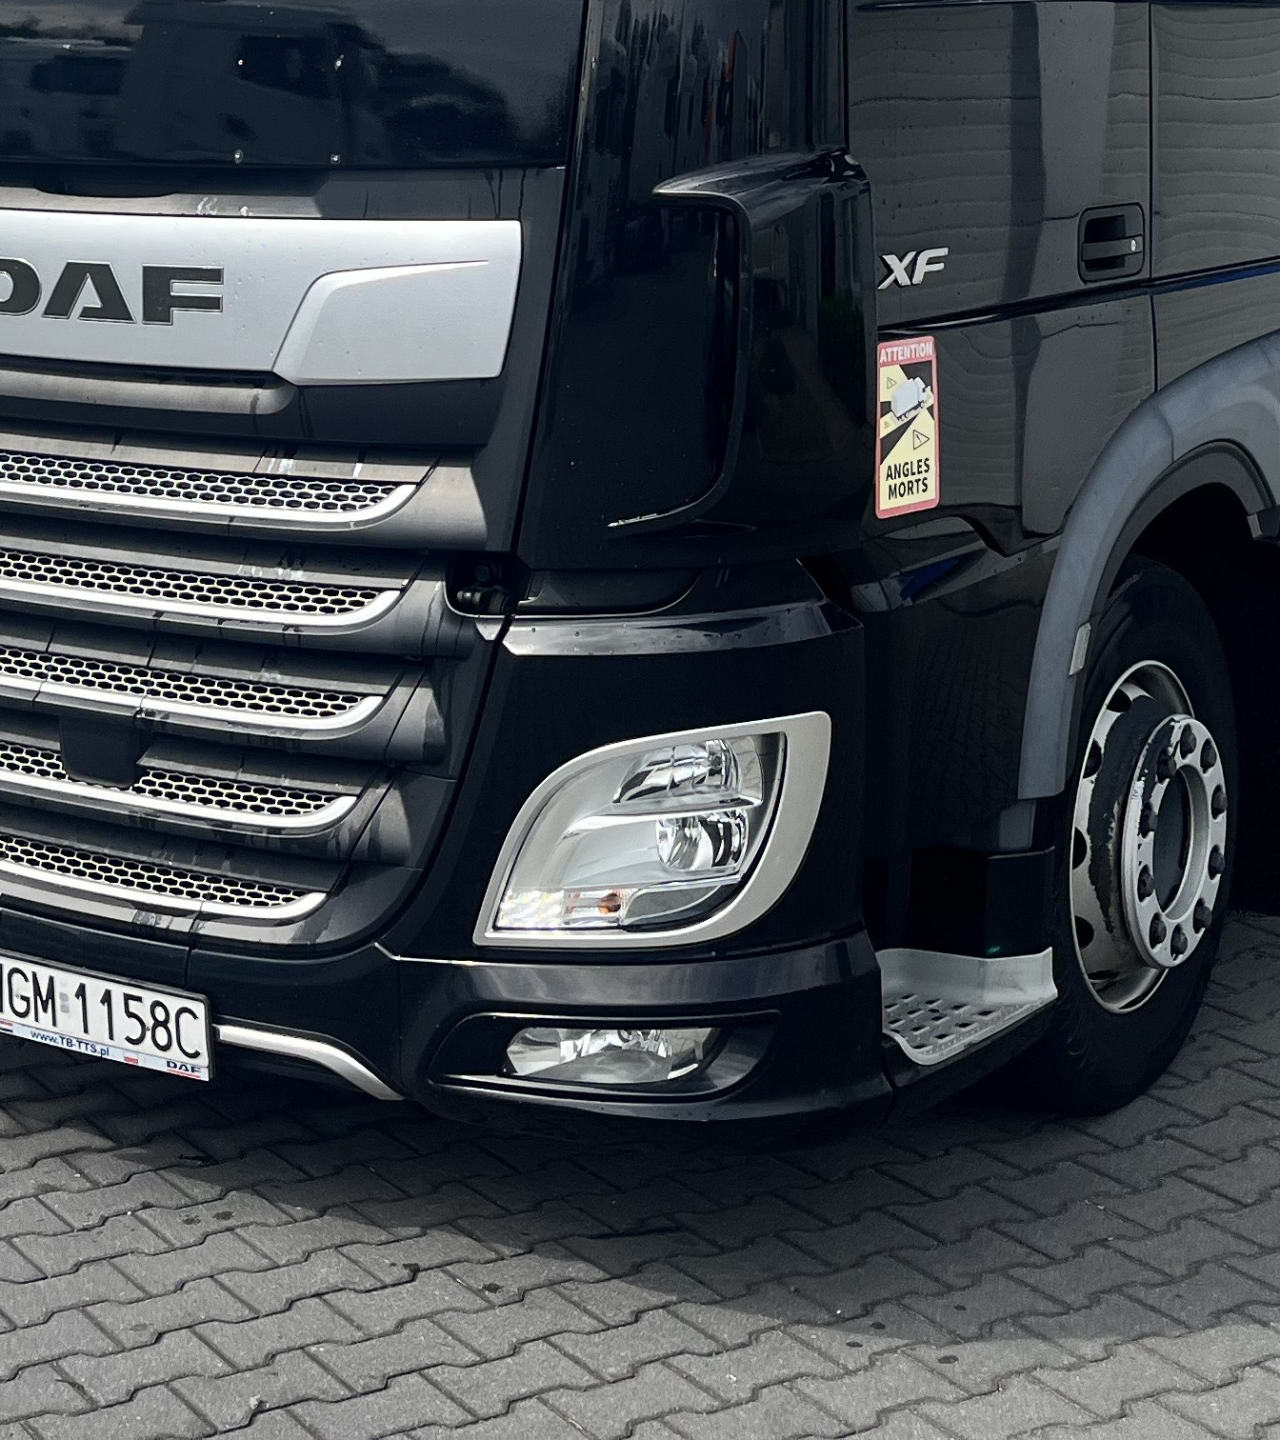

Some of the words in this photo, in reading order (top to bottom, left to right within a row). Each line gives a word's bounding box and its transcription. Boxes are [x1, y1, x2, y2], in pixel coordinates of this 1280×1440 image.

[878, 247, 949, 289] XF
[879, 341, 934, 363] ATTENTION
[885, 457, 931, 481] ANGLES
[887, 478, 929, 500] MORTS
[74, 981, 201, 1059] 1158C
[30, 1030, 110, 1058] www.TB-TTS.pl
